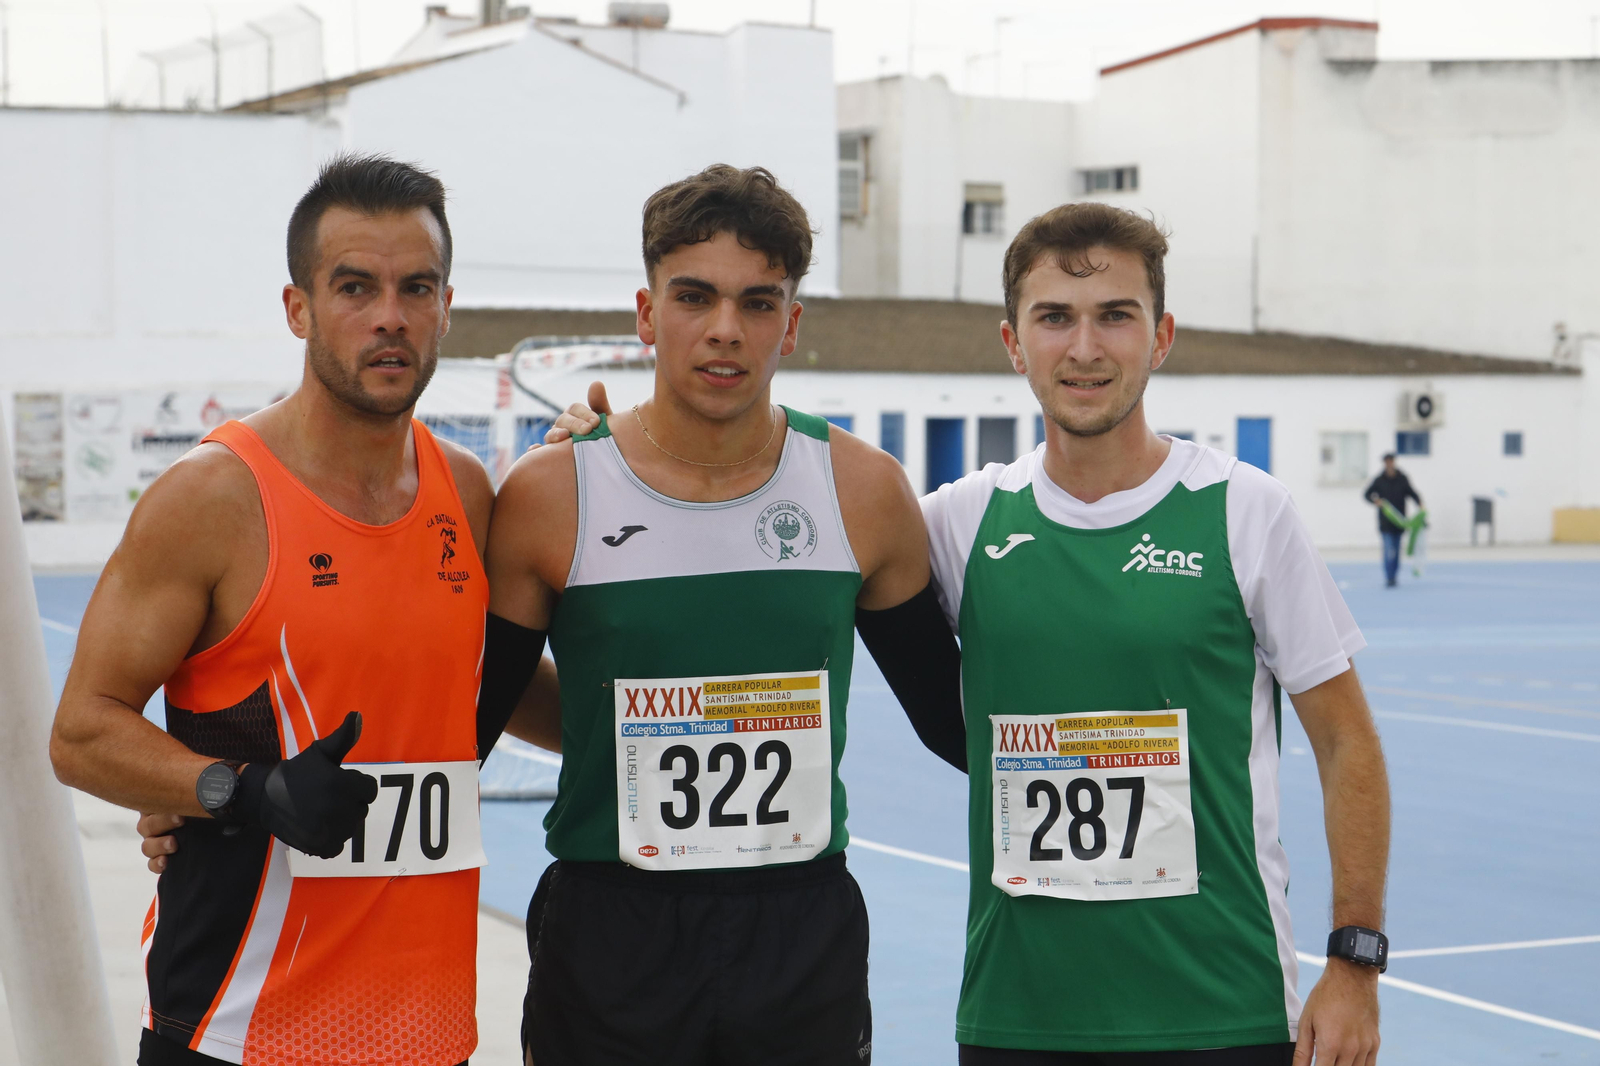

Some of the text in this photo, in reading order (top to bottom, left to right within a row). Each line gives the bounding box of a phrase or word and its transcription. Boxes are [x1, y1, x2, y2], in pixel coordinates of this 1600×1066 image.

[760, 516, 766, 524] DE
[767, 503, 799, 515] ATLETISMO
[1149, 549, 1203, 571] CAC
[312, 572, 338, 581] SPORTING
[437, 572, 446, 581] DE
[705, 681, 782, 692] CARRERA POPULAR
[625, 687, 702, 717] XXXIX
[705, 692, 792, 704] SANTÍSIMA TRINIDAD
[705, 706, 747, 715] MEMORIAL
[622, 721, 728, 737] Colegio Stma. Trinidad
[737, 716, 820, 731] TRINITARIOS
[1058, 718, 1134, 729] CARRERA POPULAR
[999, 723, 1058, 752] XXXIX
[1060, 729, 1145, 740] SANTÍSIMA TRINIDAD
[1060, 742, 1099, 752] MEMORIAL
[996, 757, 1081, 771] Colegio Stma. Trinidad
[1090, 753, 1179, 767] TRINITARIOS
[659, 739, 792, 830] 322
[1026, 776, 1145, 862] 287
